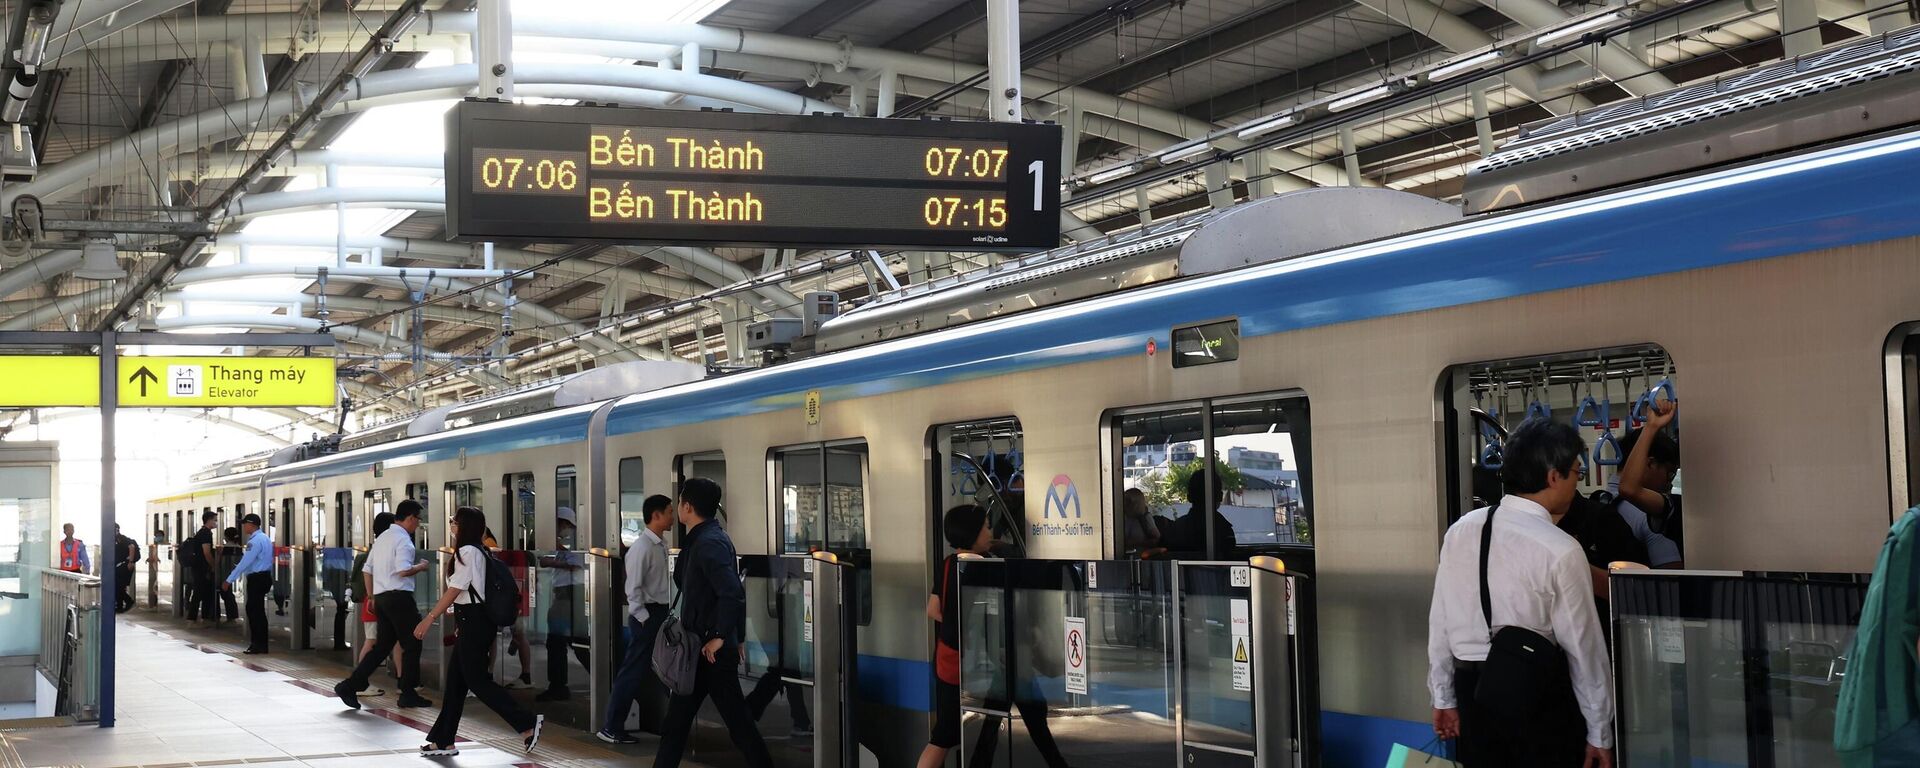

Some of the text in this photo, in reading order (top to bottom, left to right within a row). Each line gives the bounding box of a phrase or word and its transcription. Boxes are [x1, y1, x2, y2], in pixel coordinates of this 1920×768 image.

[481, 157, 577, 190] 07:06
[590, 130, 1008, 178] Bến Thành 07:07
[589, 181, 1007, 228] Bến Thành 07:15
[1028, 160, 1044, 211] 1
[208, 386, 259, 398] Elevator
[209, 365, 306, 384] Thang máy
